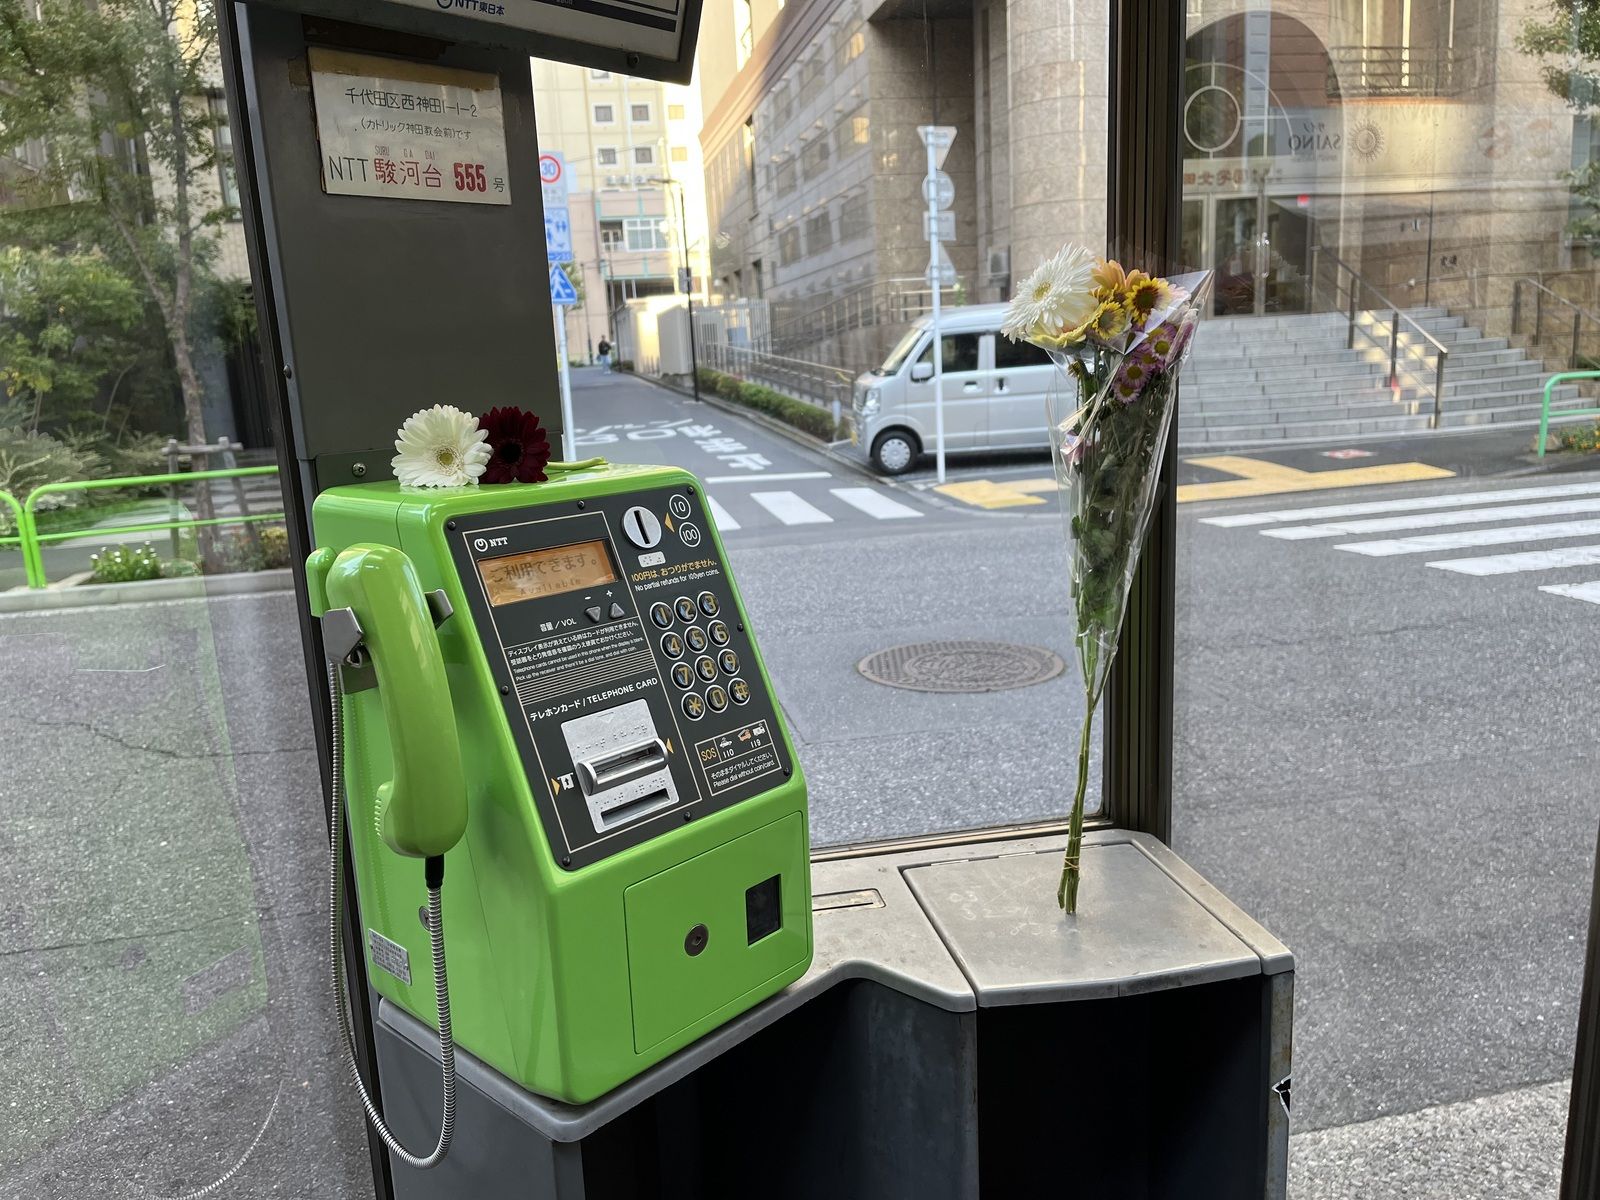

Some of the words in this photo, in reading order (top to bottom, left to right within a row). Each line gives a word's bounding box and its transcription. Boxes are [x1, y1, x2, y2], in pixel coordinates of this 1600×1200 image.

[374, 146, 390, 156] SURU
[403, 148, 413, 159] GA
[329, 155, 369, 182] NTT
[374, 158, 442, 188] 駿河台
[453, 162, 487, 192] 555
[493, 177, 505, 192] 号
[542, 162, 556, 176] 30
[674, 501, 686, 513] 10
[489, 537, 508, 547] NTT
[682, 529, 698, 541] 100
[490, 553, 597, 583] ご利用できます。
[682, 601, 694, 620] 2
[705, 595, 716, 613] 3
[561, 618, 577, 627] VOL
[660, 607, 668, 624] 1
[691, 630, 704, 649] 5
[716, 624, 727, 643] 6
[671, 637, 680, 654] 4
[702, 660, 714, 679] 8
[725, 654, 736, 672] 9
[678, 667, 688, 685] 7
[530, 700, 581, 721] テレホンカード
[587, 684, 635, 704] TELEPHONE
[636, 678, 658, 690] CARD
[712, 689, 724, 708] 0
[750, 739, 761, 748] 119
[701, 747, 717, 761] SOS
[723, 748, 734, 758] 110
